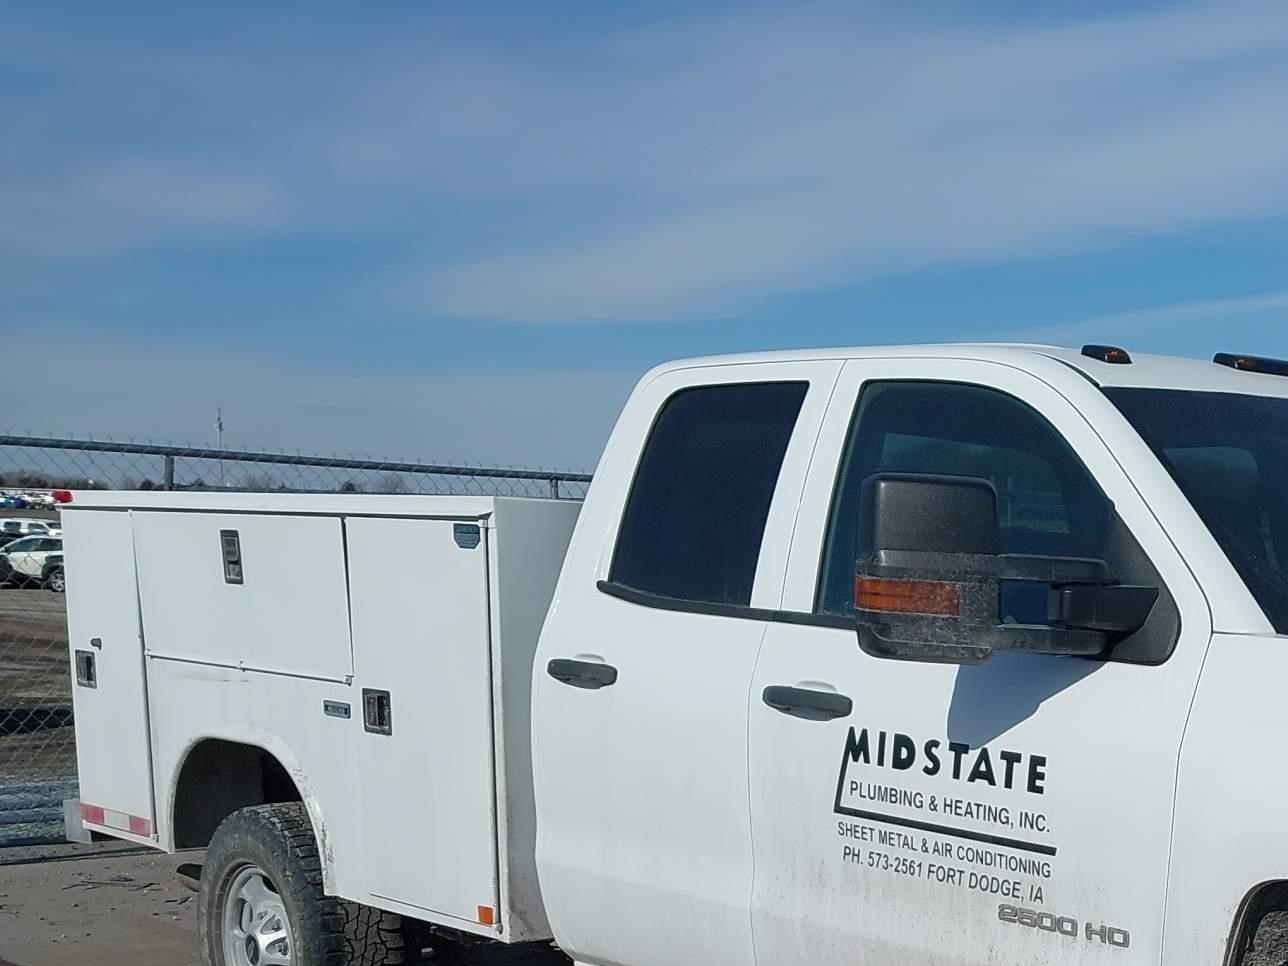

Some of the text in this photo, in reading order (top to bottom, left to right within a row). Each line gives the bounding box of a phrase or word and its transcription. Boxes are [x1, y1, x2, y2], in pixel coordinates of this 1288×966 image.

[847, 726, 1047, 794] MIDSTATE
[850, 780, 1051, 832] PLUMBING & HEATING, INC.
[838, 821, 1051, 878] SHEET METAL & AIR CONDITIONING
[843, 845, 1044, 904] PH. 573-2561 FORT DODGE, IA
[998, 903, 1130, 948] 2500 HD
